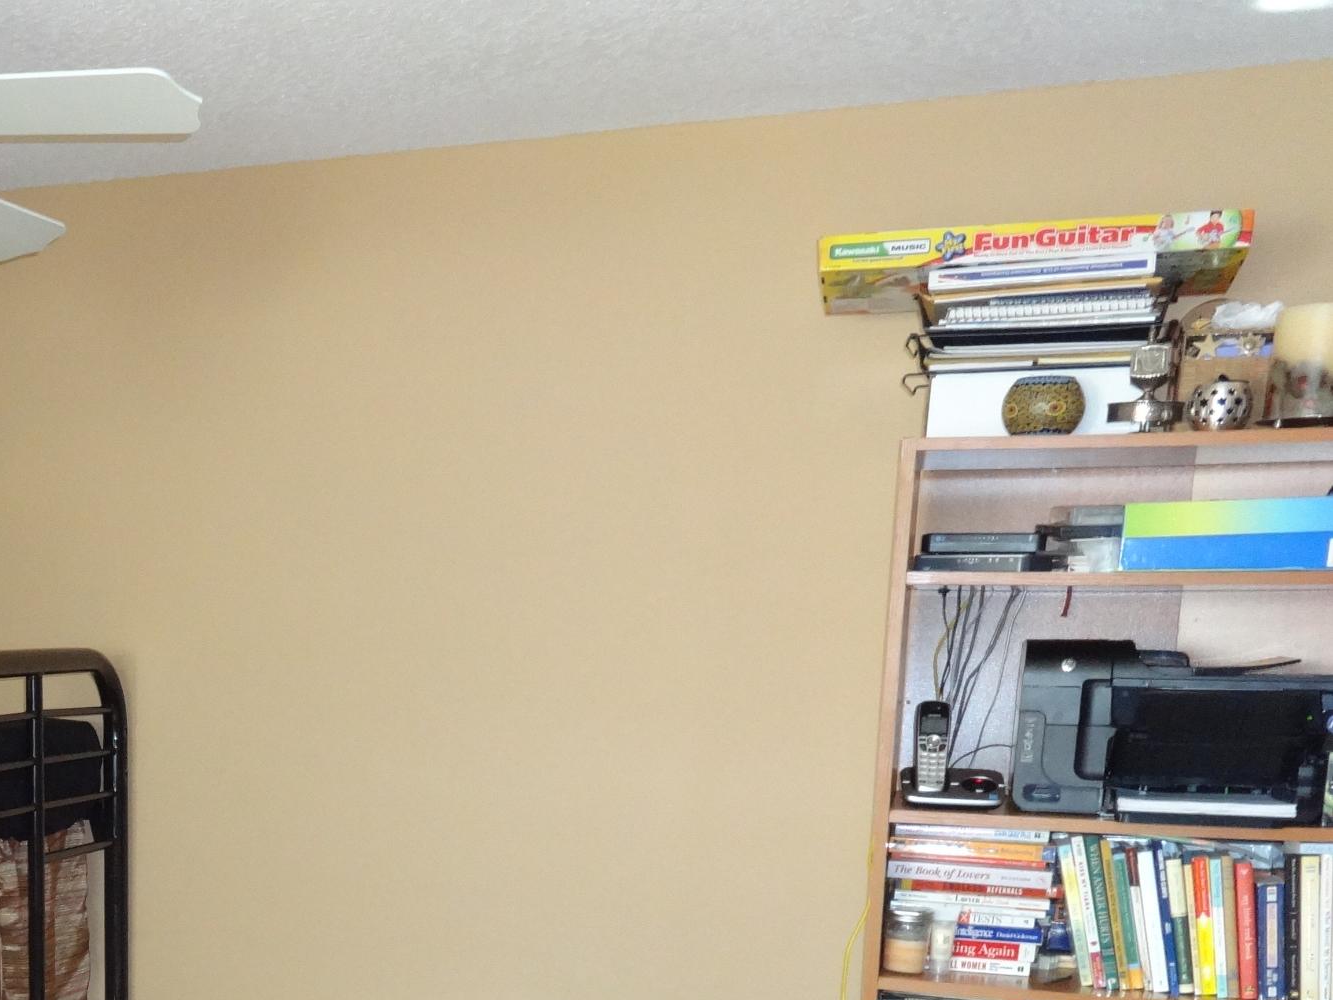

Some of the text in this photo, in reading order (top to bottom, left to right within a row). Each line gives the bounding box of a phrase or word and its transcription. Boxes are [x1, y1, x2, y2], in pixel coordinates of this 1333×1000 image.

[972, 231, 1030, 253] Fun
[1034, 223, 1137, 248] Guitar
[891, 242, 928, 252] MUSIC
[894, 864, 912, 874] The
[915, 866, 942, 878] Book
[944, 868, 956, 880] of
[956, 869, 991, 881] Lovers
[986, 886, 1023, 896] REFERRALS
[1077, 860, 1086, 877] KISS
[1082, 890, 1091, 911] TIARA
[1089, 843, 1111, 944] WHEN ANGER HURTS
[970, 914, 1003, 925] TESTS
[953, 943, 1016, 958] ing Again
[961, 960, 987, 971] WOMEN
